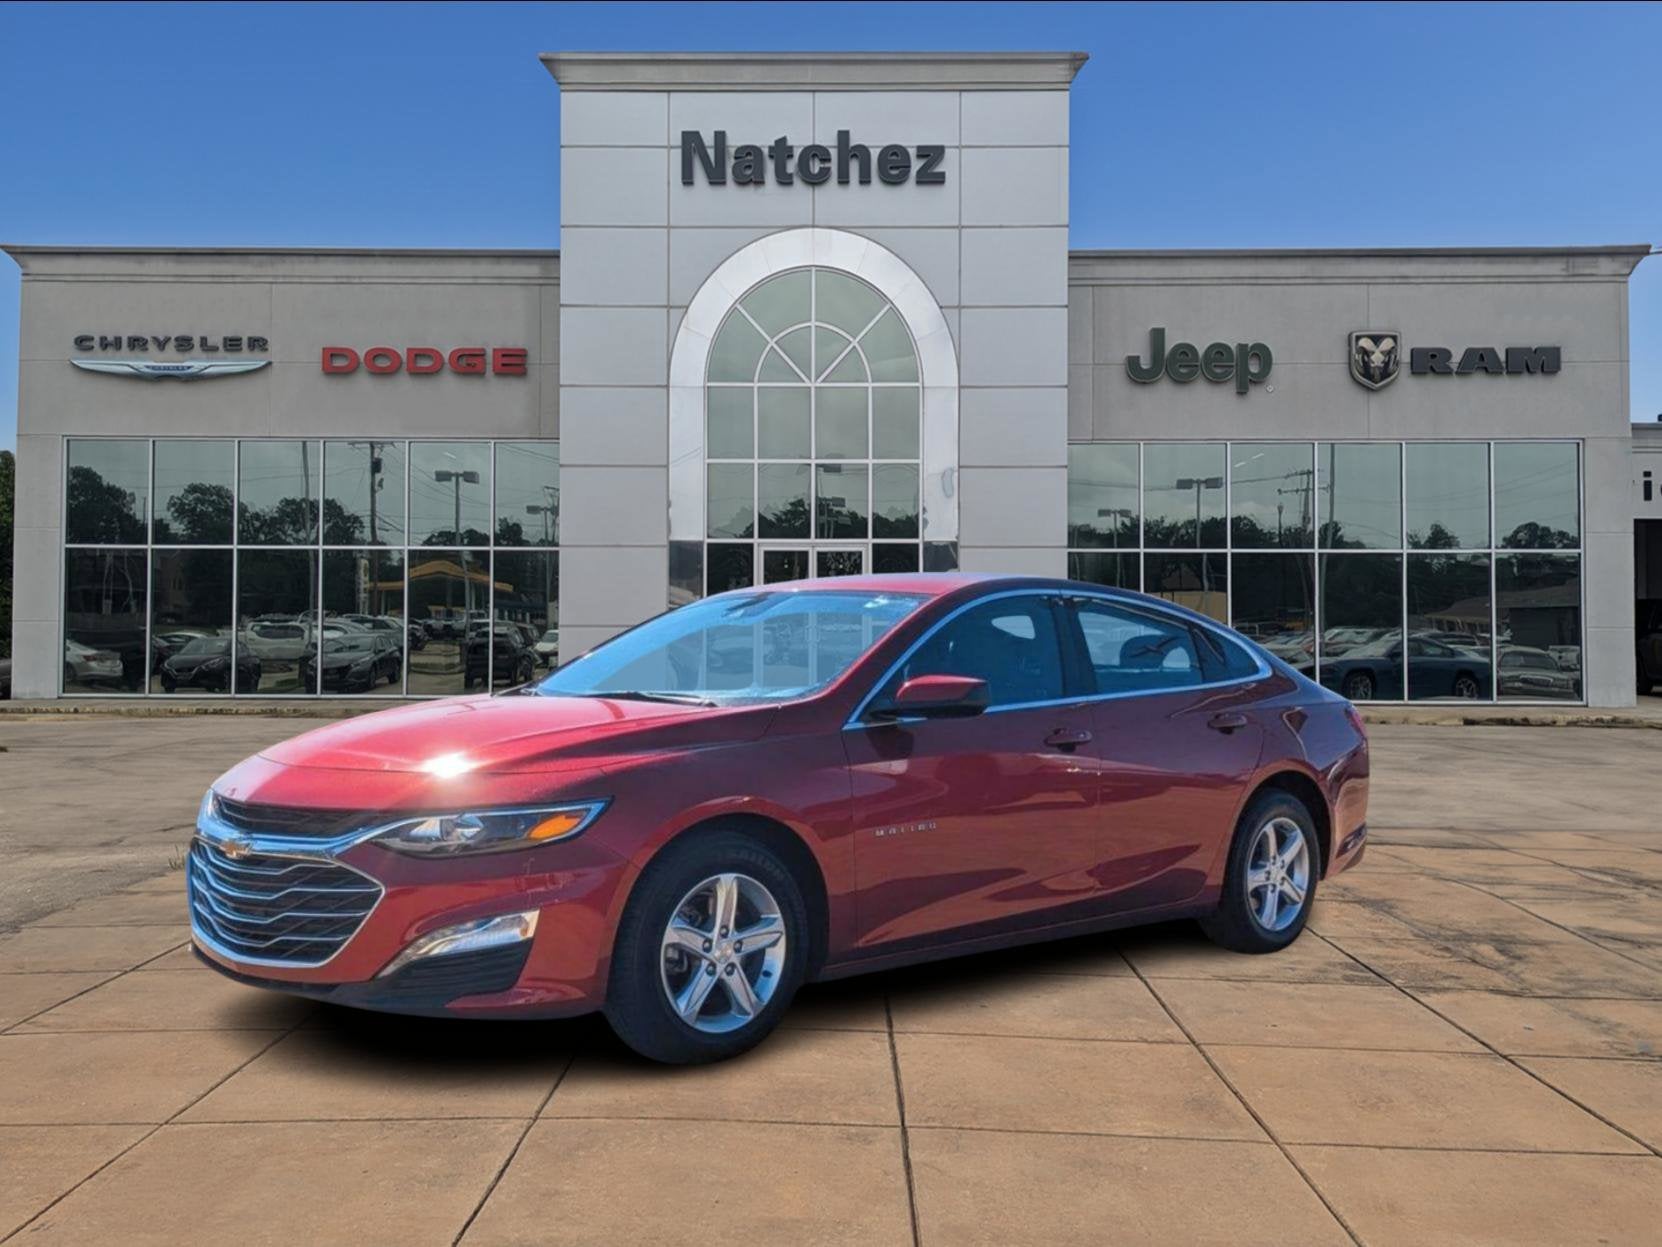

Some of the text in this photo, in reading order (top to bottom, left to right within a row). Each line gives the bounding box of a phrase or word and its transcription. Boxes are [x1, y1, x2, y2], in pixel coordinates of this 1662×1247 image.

[681, 130, 946, 185] Natchez
[74, 335, 269, 352] CHRYSLER
[321, 347, 528, 375] DODGE
[1126, 327, 1273, 394] Jeep
[1410, 347, 1561, 375] RAM
